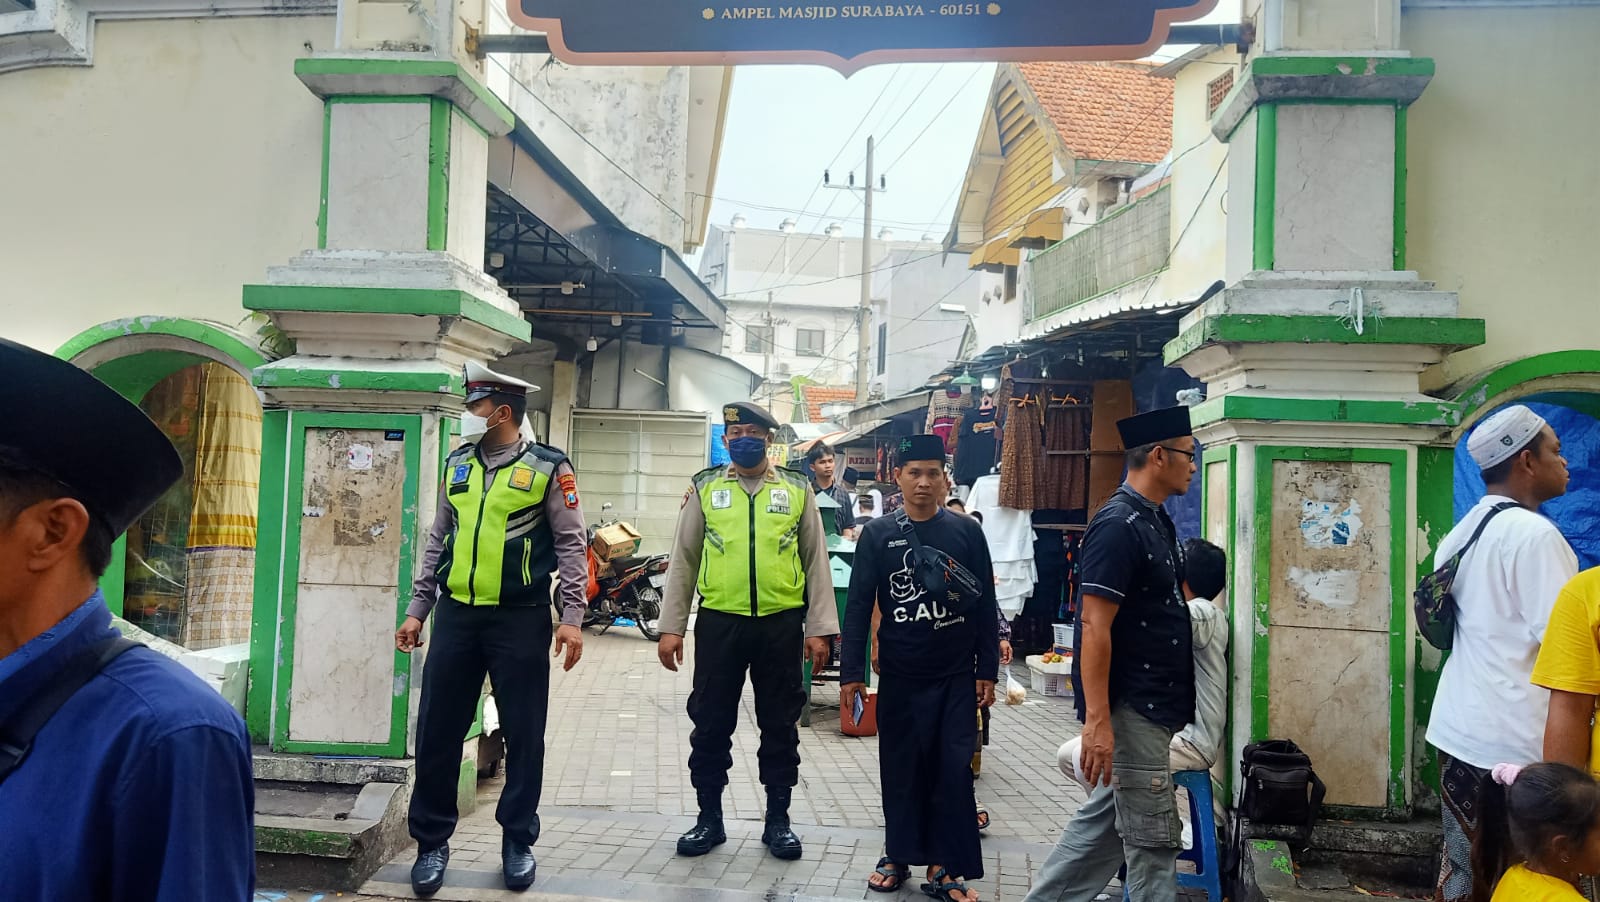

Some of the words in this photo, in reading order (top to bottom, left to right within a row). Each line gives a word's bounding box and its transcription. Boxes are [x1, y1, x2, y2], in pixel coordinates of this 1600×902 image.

[721, 7, 776, 20] AMPEL
[779, 6, 838, 20] MASJID
[841, 4, 925, 18] SURABAYA
[940, 3, 981, 16] 60151
